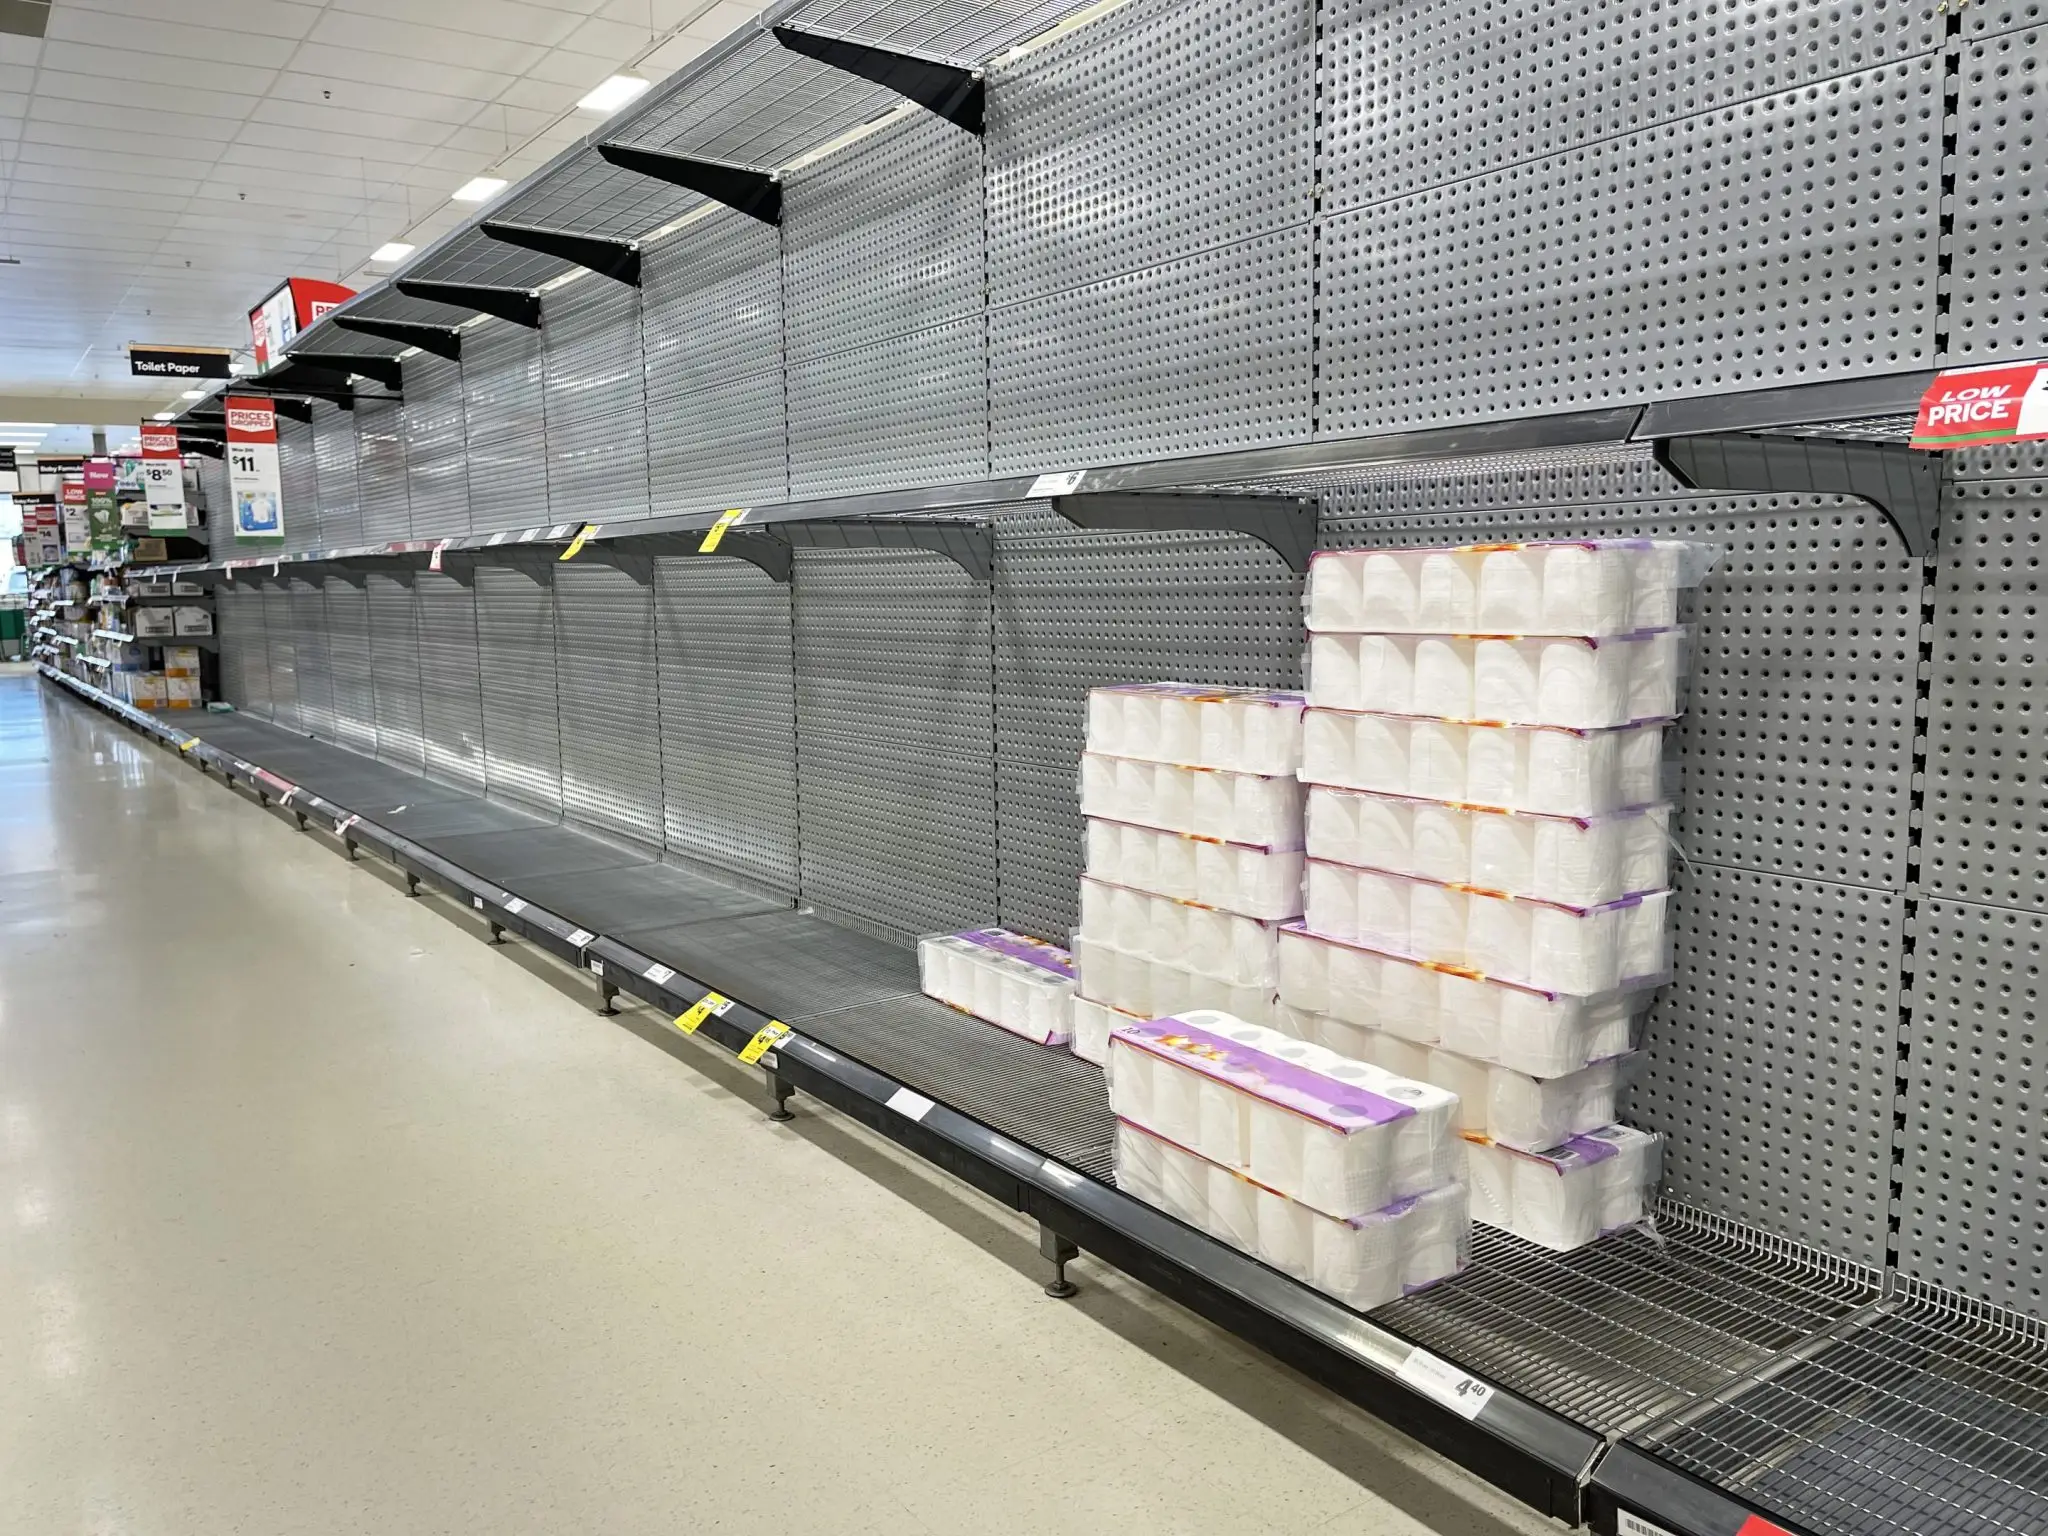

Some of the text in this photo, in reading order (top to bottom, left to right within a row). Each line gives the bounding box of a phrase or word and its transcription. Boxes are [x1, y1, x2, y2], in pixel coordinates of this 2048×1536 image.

[134, 361, 201, 375] Toilet Paper
[1939, 384, 2012, 403] LOW
[230, 411, 271, 421] PRICES
[1927, 399, 2012, 427] PRICE
[231, 419, 271, 427] DROPPED
[232, 455, 255, 472] $11
